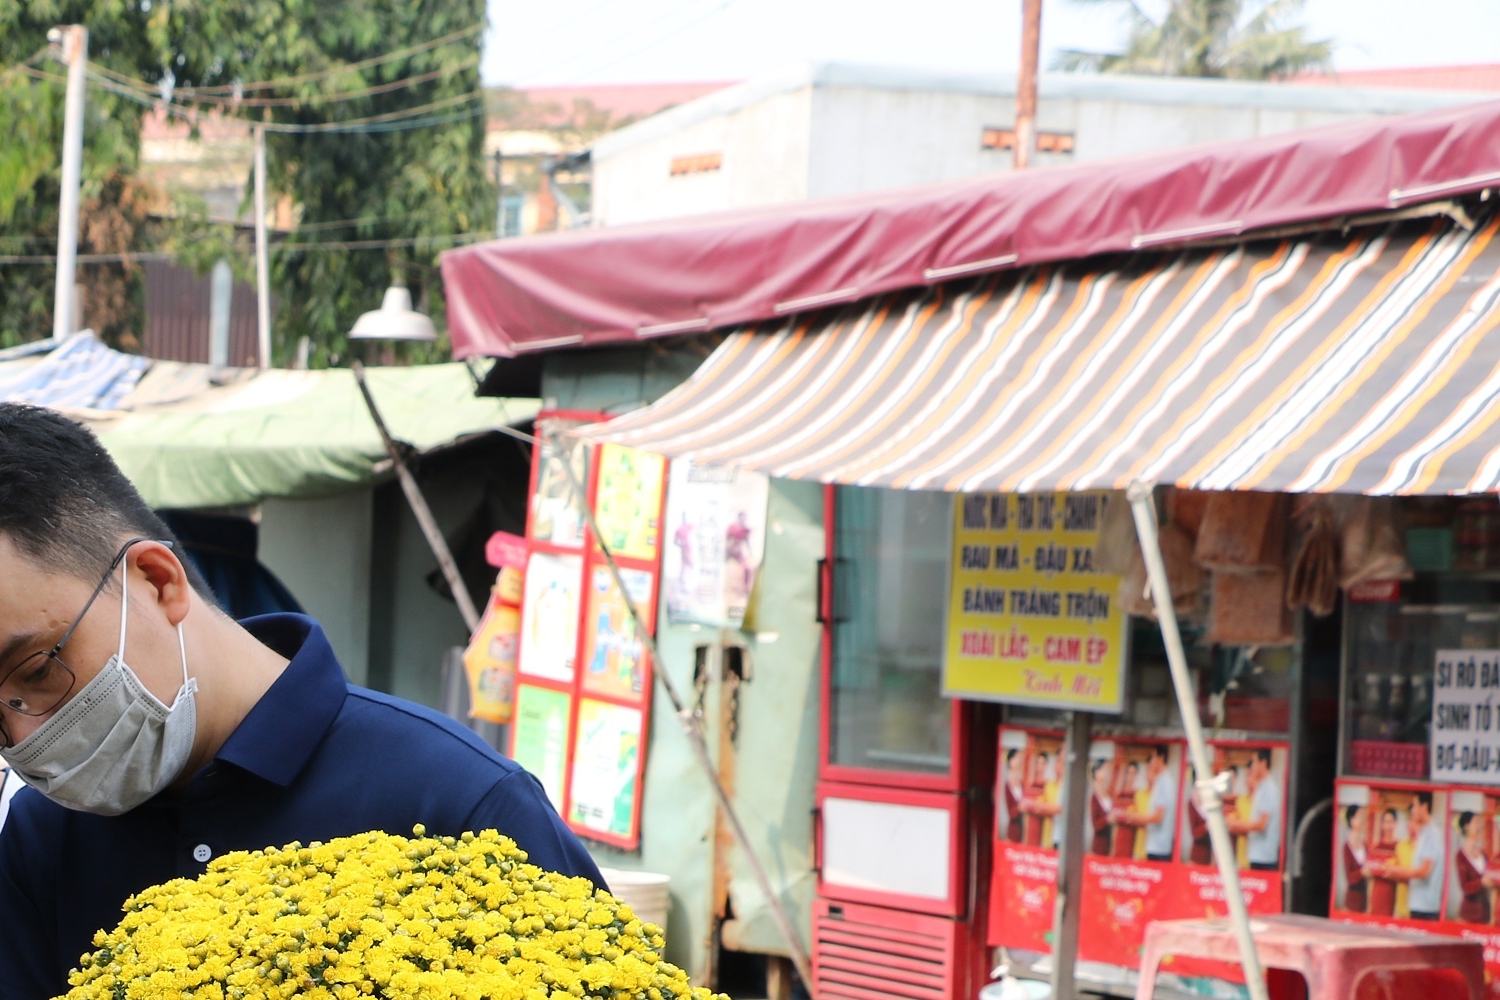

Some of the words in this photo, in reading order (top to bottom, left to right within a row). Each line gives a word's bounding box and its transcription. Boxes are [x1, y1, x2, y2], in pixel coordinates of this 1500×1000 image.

[962, 545, 990, 569] RAU
[996, 541, 1018, 570] MÁ
[964, 585, 1005, 613] BÁNH
[1011, 585, 1061, 616] TRÁNG
[1067, 587, 1110, 624] TRỘN
[1045, 636, 1082, 662] CAM
[1436, 660, 1453, 688] SI
[1436, 702, 1471, 731] SINH
[1475, 693, 1494, 732] TỐ
